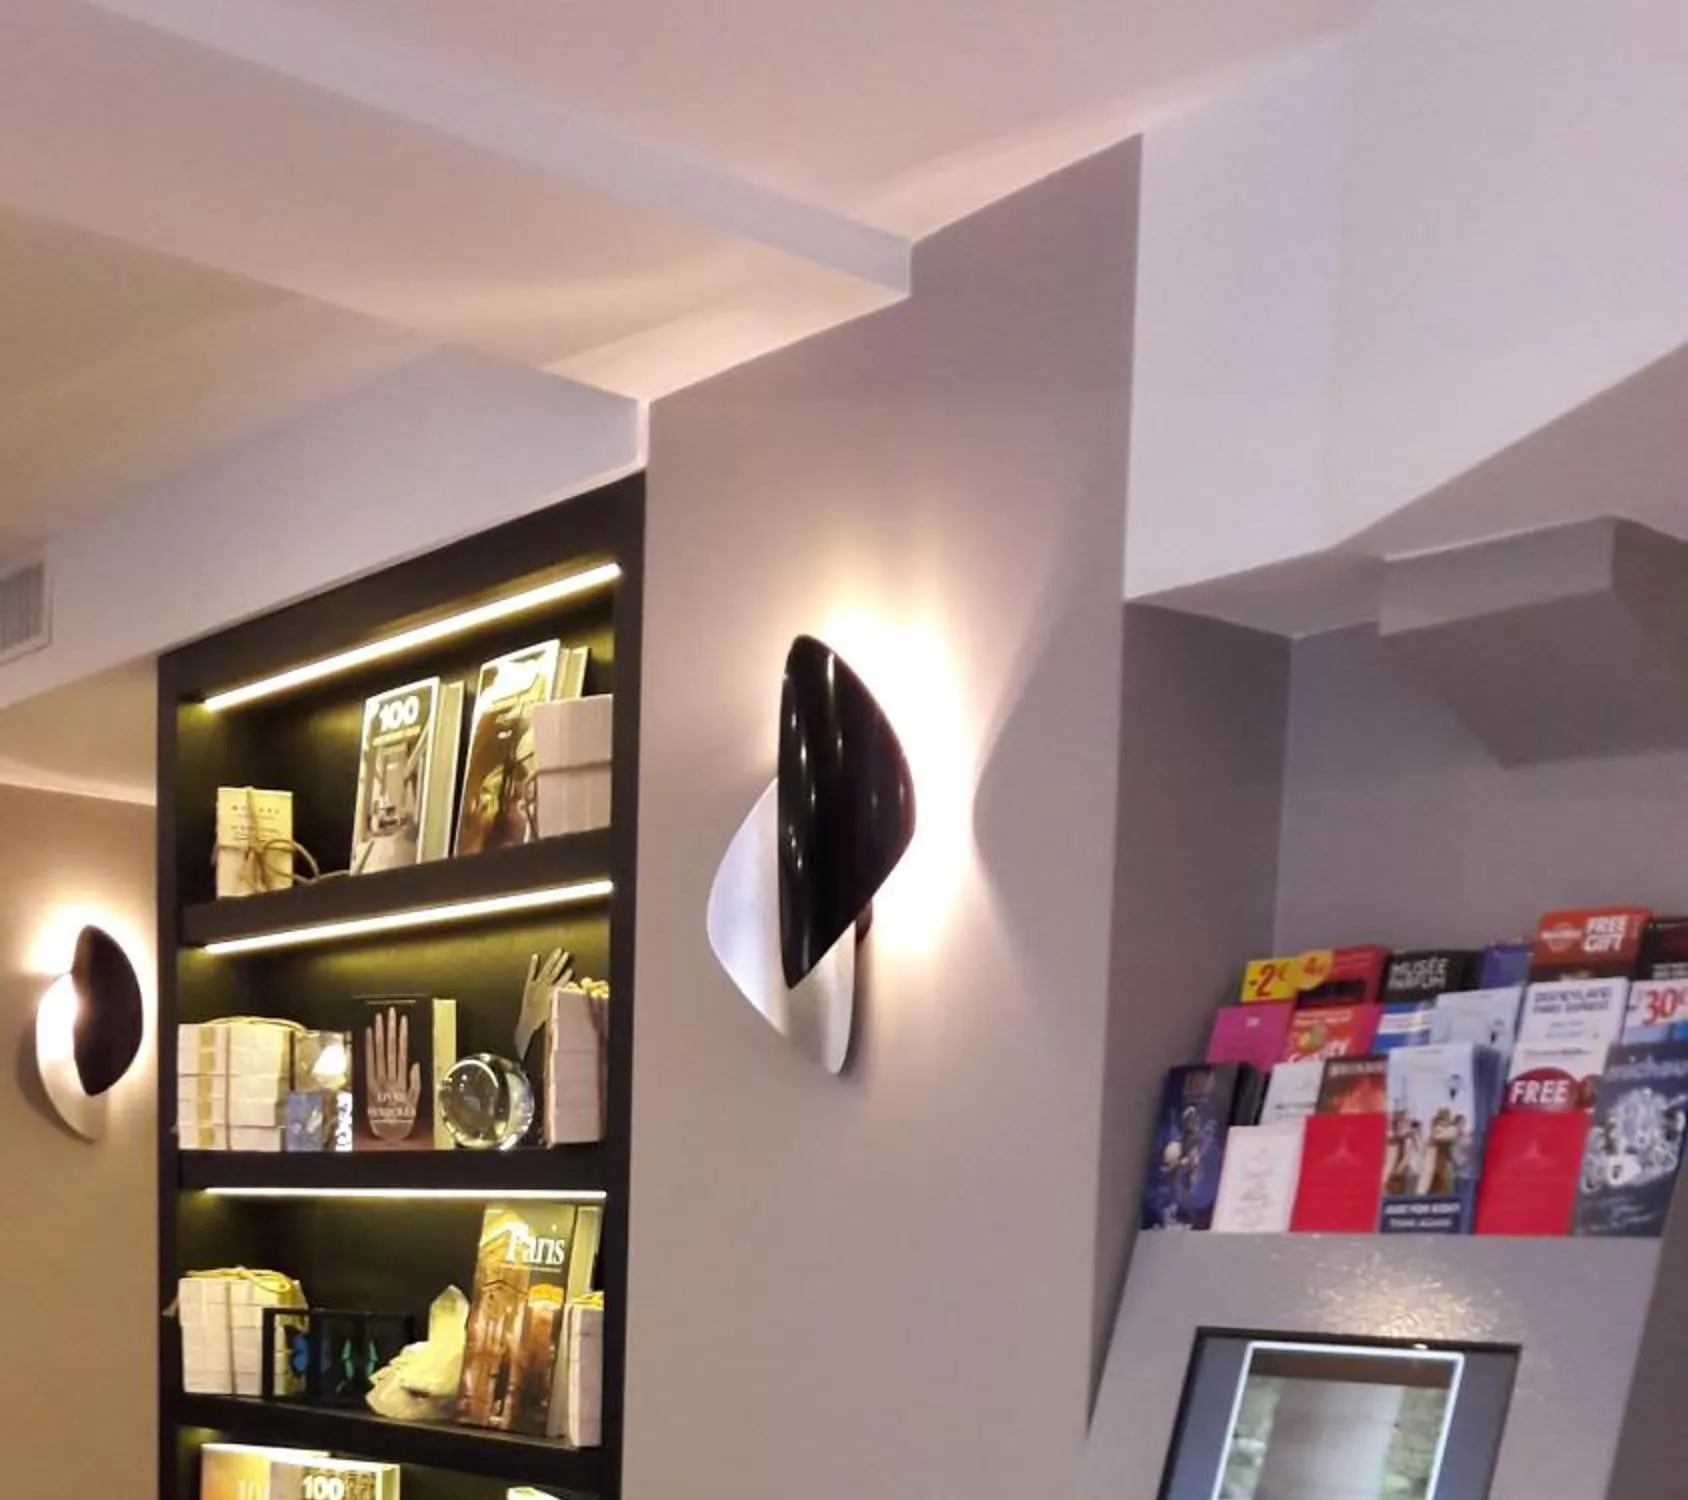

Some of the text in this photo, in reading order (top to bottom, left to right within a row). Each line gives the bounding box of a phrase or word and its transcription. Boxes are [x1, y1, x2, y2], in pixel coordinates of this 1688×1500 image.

[379, 695, 419, 732] 100
[1586, 915, 1629, 934] FREE
[1582, 933, 1625, 952] GIFT
[1510, 1079, 1570, 1105] FREE
[504, 1221, 565, 1265] Paris
